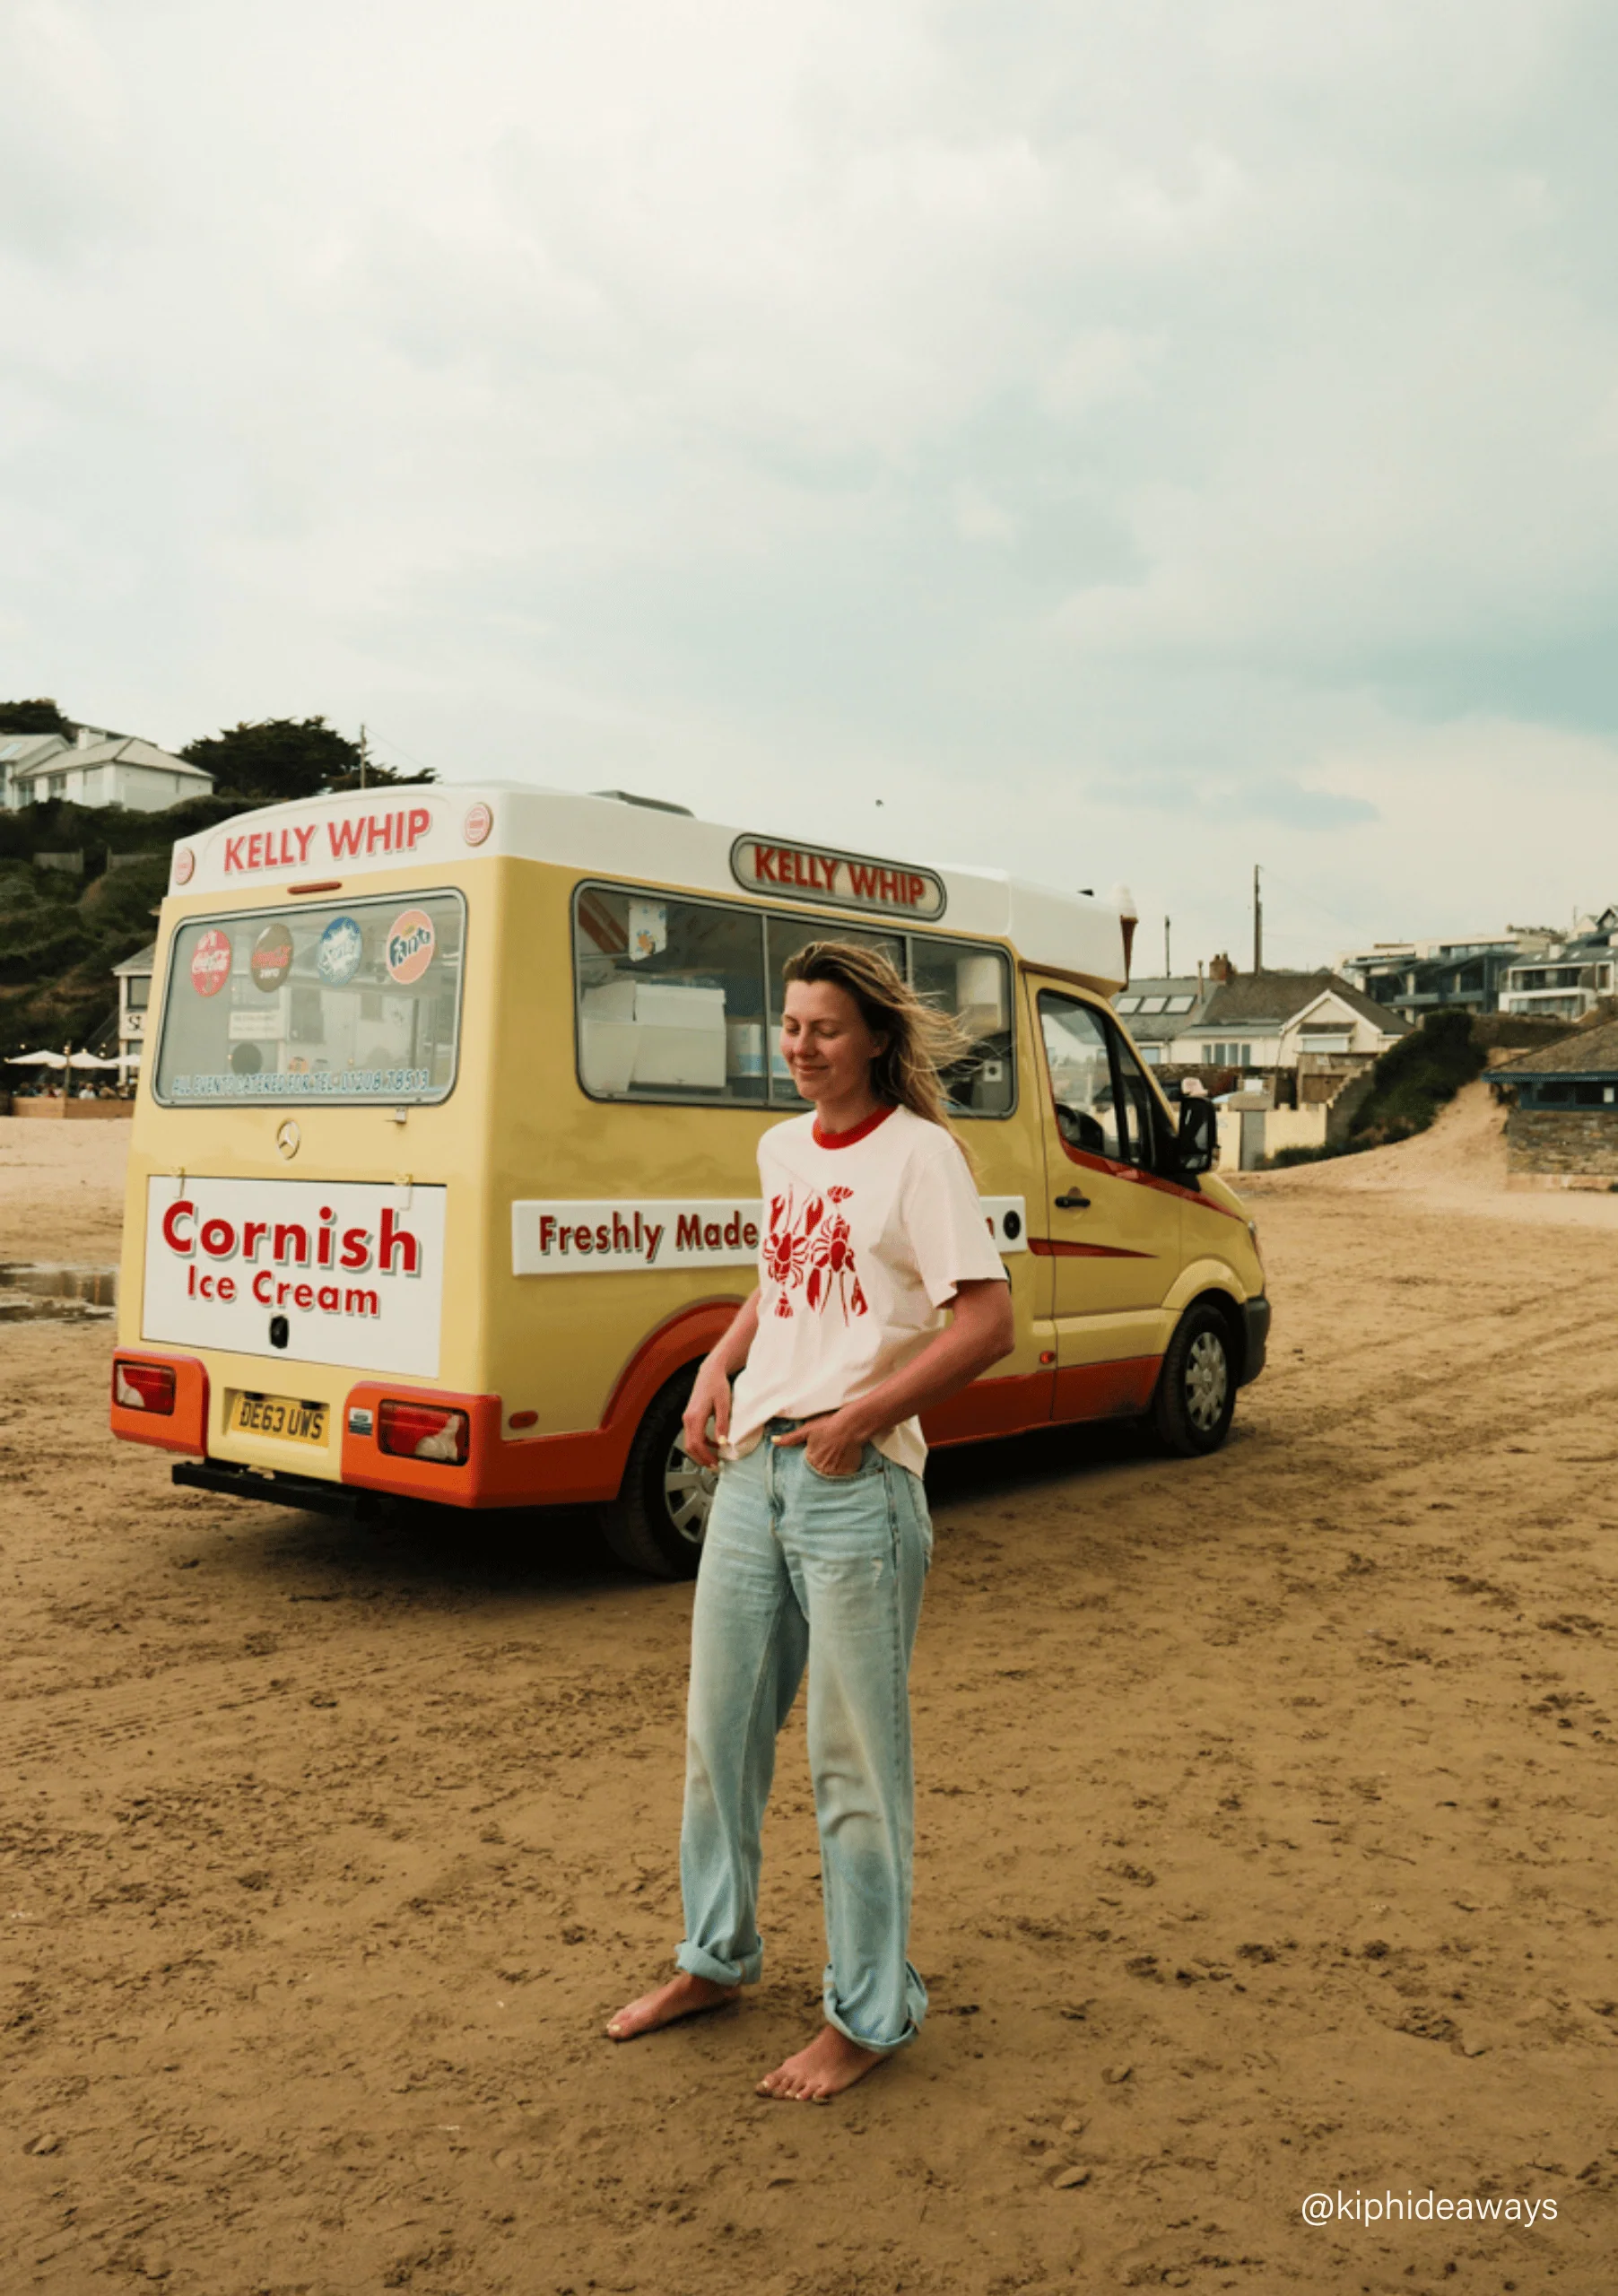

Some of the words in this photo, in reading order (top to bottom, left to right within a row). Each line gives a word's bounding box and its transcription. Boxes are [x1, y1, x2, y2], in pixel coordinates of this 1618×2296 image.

[223, 823, 318, 874] KELLY
[327, 807, 432, 859] WHIP
[753, 845, 839, 892] KELLY
[848, 863, 926, 906] WHIP
[161, 1199, 422, 1277] Cornish
[539, 1210, 665, 1264] Freshly
[675, 1210, 760, 1252] Made
[187, 1265, 237, 1300] Ice
[252, 1270, 380, 1318] Cream
[239, 1400, 286, 1432] DE63
